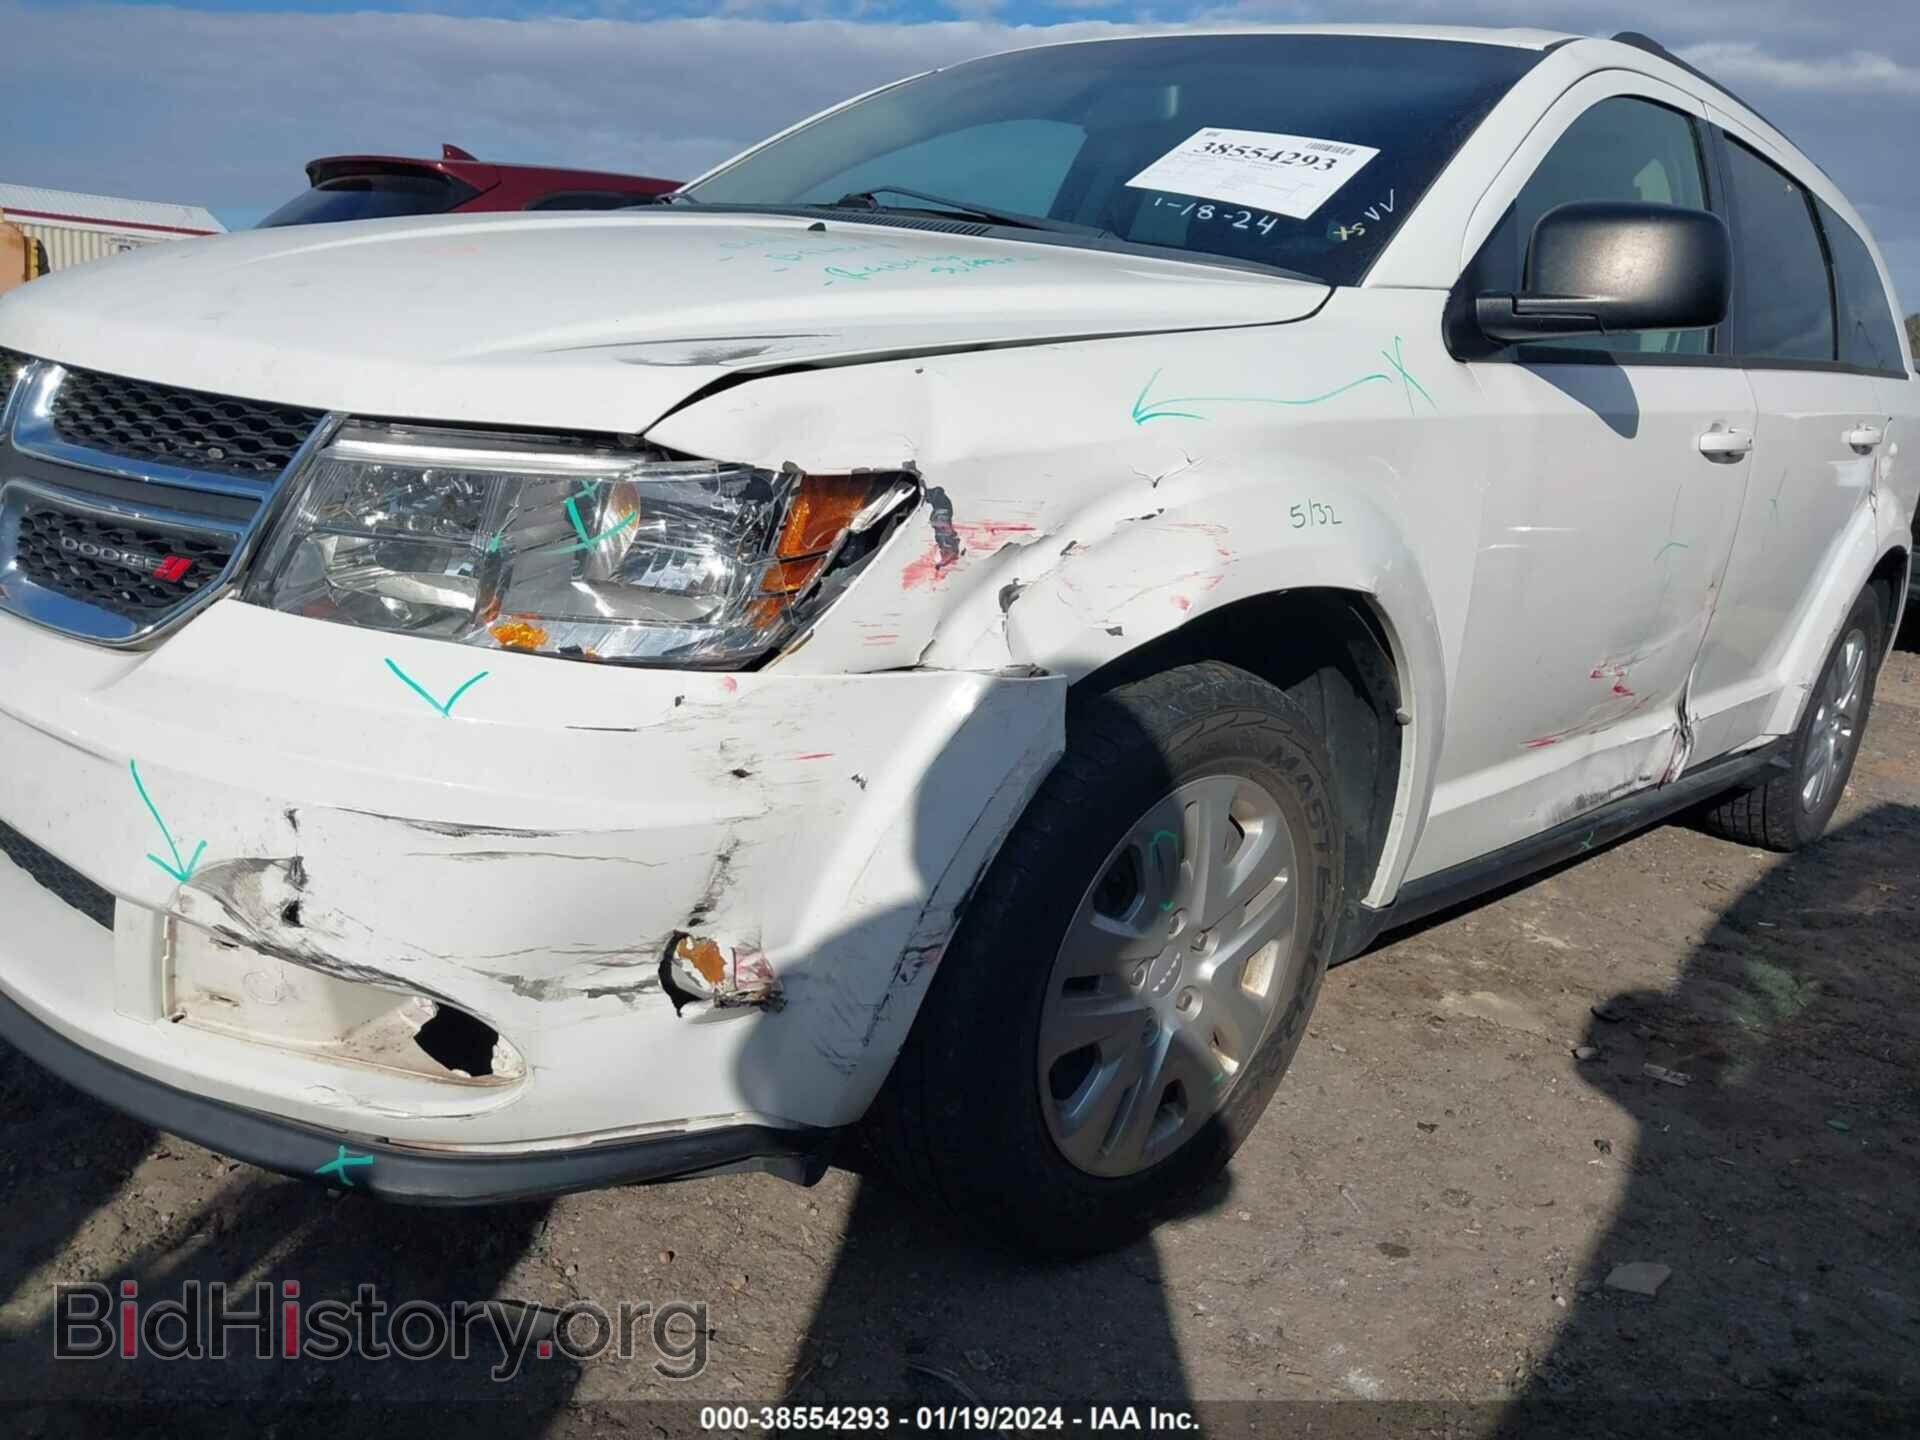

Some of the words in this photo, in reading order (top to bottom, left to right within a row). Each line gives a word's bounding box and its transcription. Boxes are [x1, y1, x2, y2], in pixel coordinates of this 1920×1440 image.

[1193, 142, 1338, 172] 38554293
[1290, 498, 1342, 528] 5/32
[61, 535, 163, 569] DODGE
